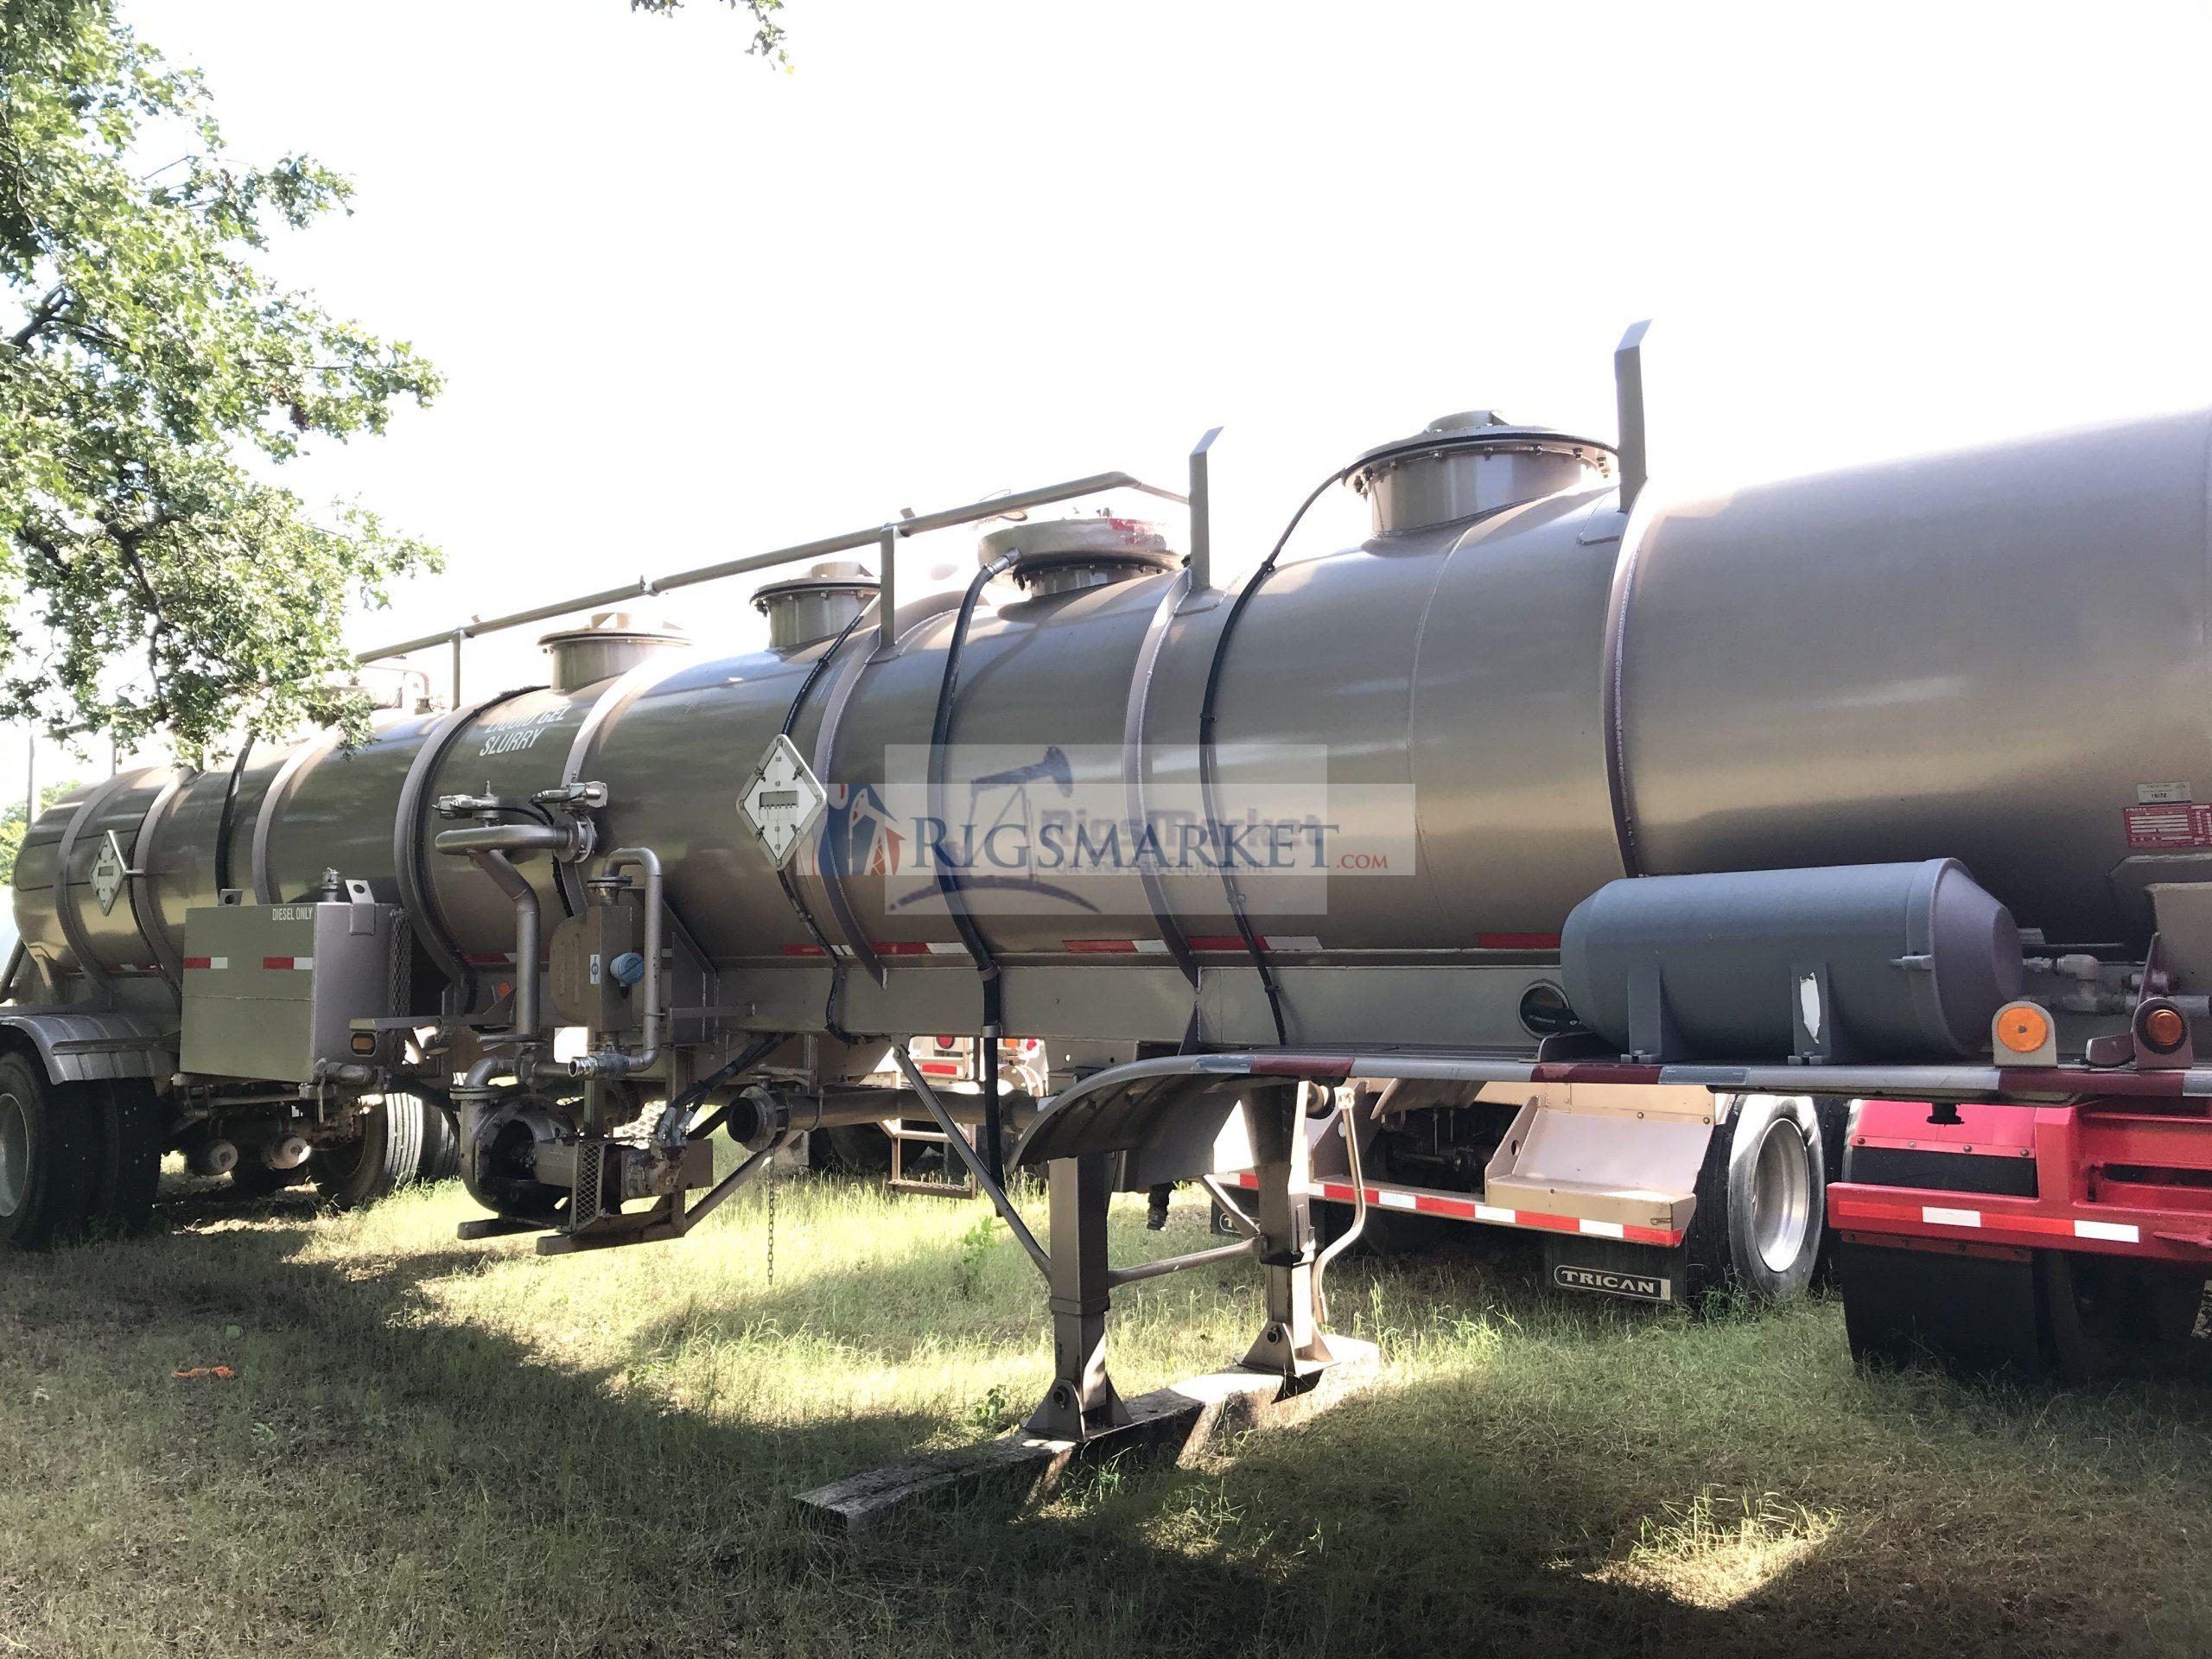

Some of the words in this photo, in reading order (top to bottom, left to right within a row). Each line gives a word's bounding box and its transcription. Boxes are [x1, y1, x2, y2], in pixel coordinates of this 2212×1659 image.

[537, 704, 572, 725] GEL
[479, 728, 546, 757] SLURRY
[272, 907, 295, 921] DIESEL
[296, 906, 313, 920] ONLY
[1560, 1270, 1655, 1294] TRICAN
